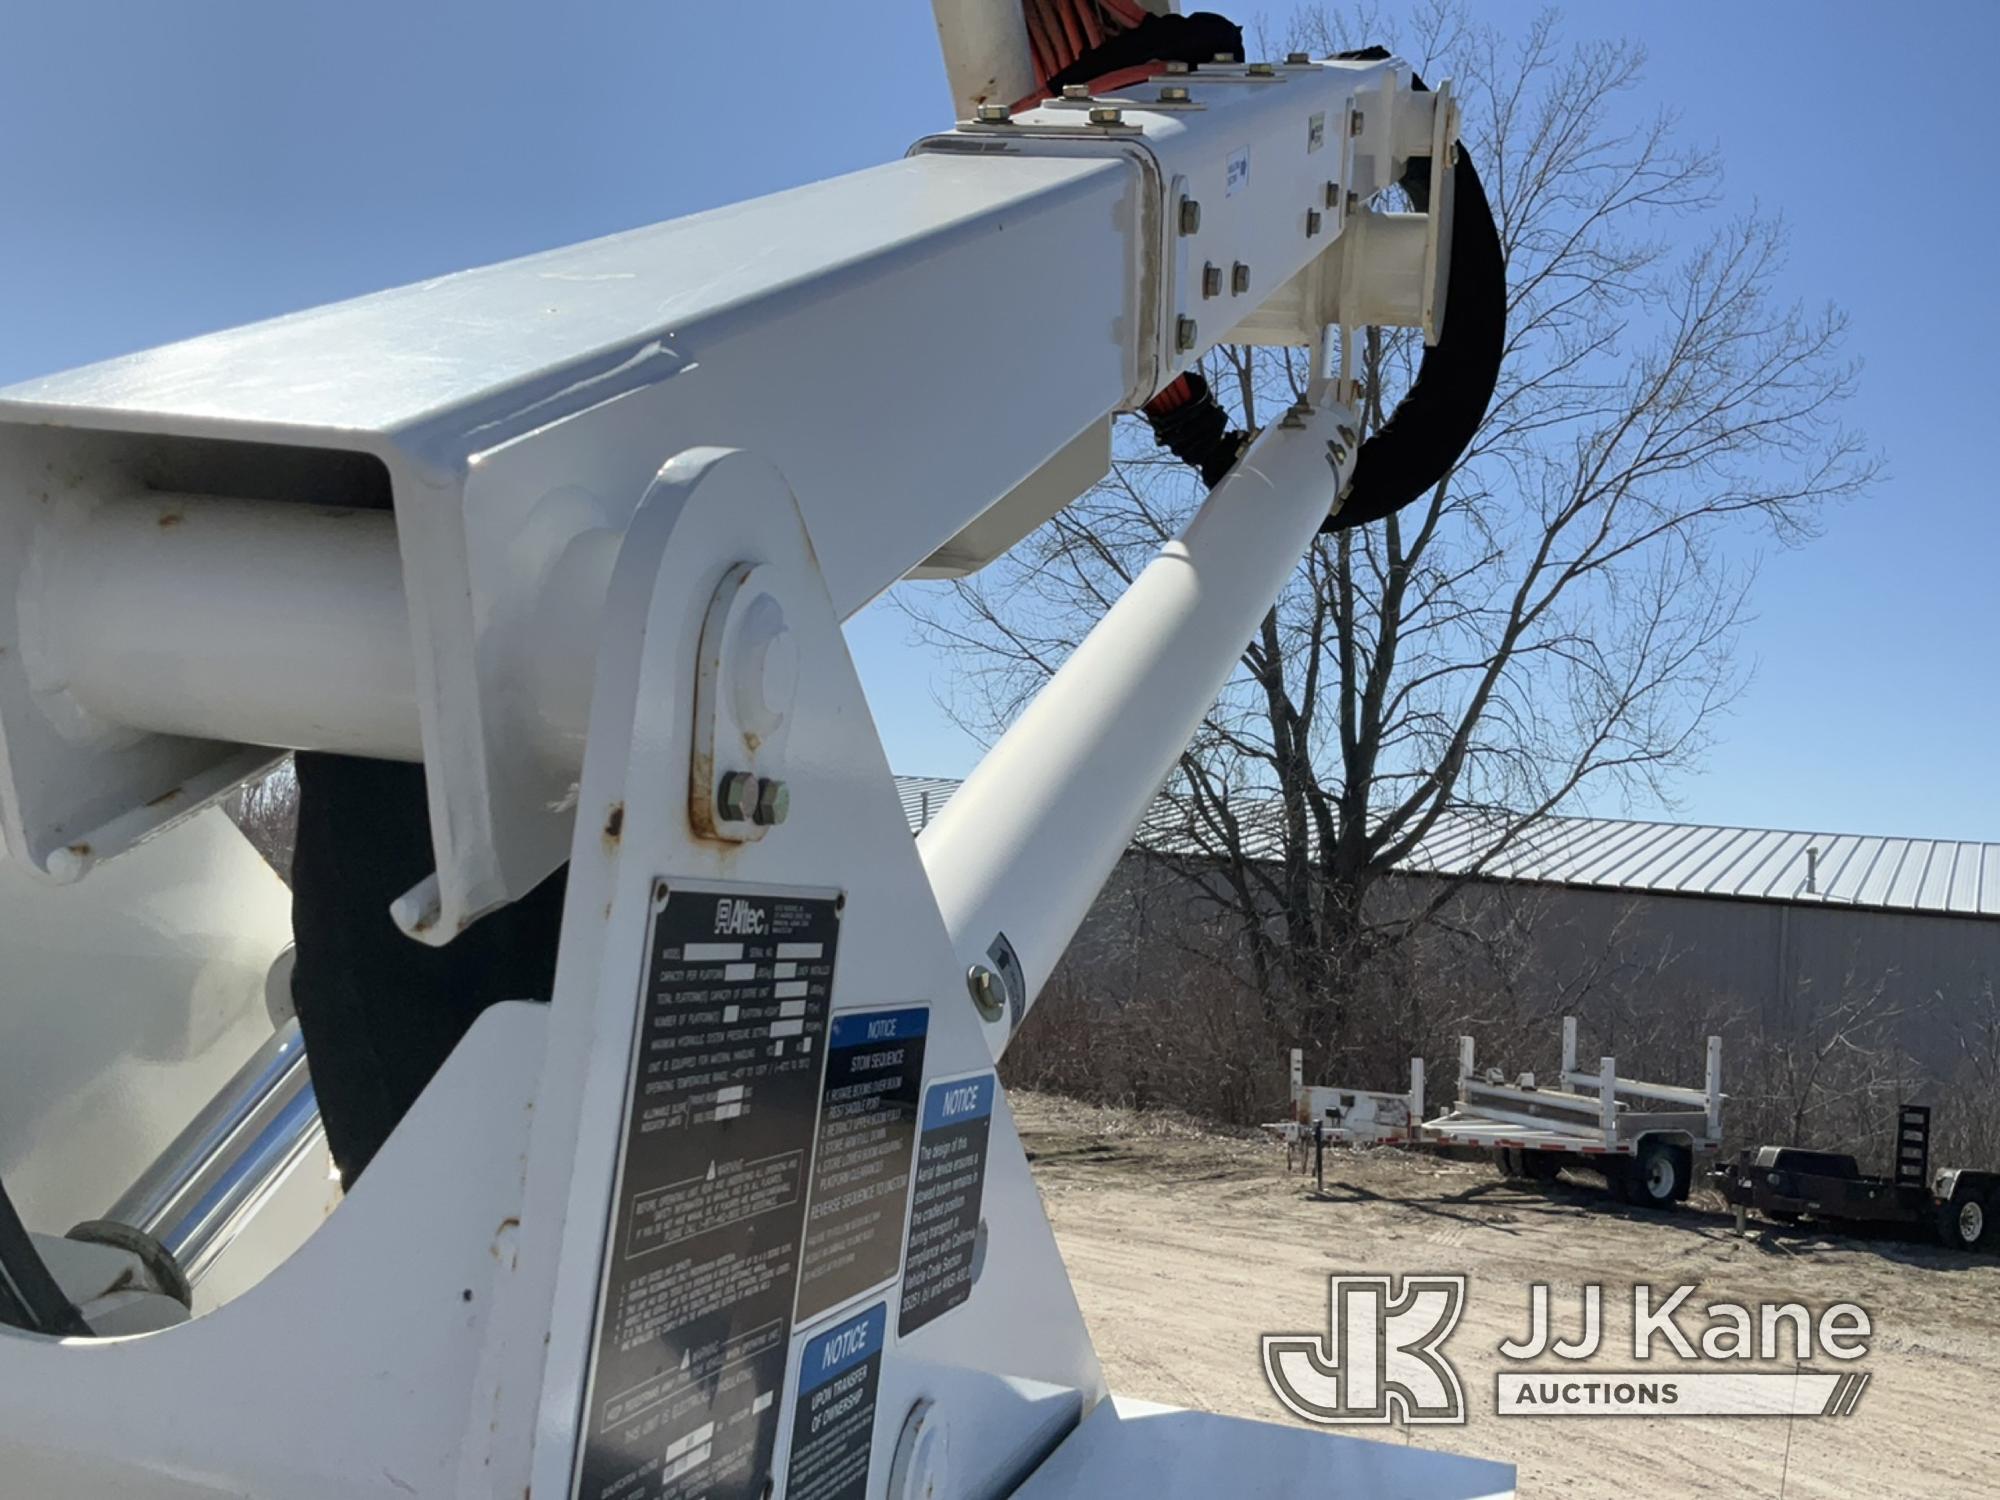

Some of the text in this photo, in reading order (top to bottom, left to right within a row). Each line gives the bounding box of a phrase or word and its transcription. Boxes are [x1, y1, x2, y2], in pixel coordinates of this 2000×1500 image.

[729, 899, 767, 934] Altec
[868, 1019, 897, 1040] NOTICE
[872, 1050, 905, 1069] SEQUENCE
[942, 1084, 979, 1119] NOTICE
[920, 1144, 933, 1163] The
[822, 1321, 868, 1371] NOTICE
[812, 1365, 868, 1412] UPON TRANSFER
[811, 1412, 822, 1434] OF
[823, 1387, 863, 1427] OWNERSHIP
